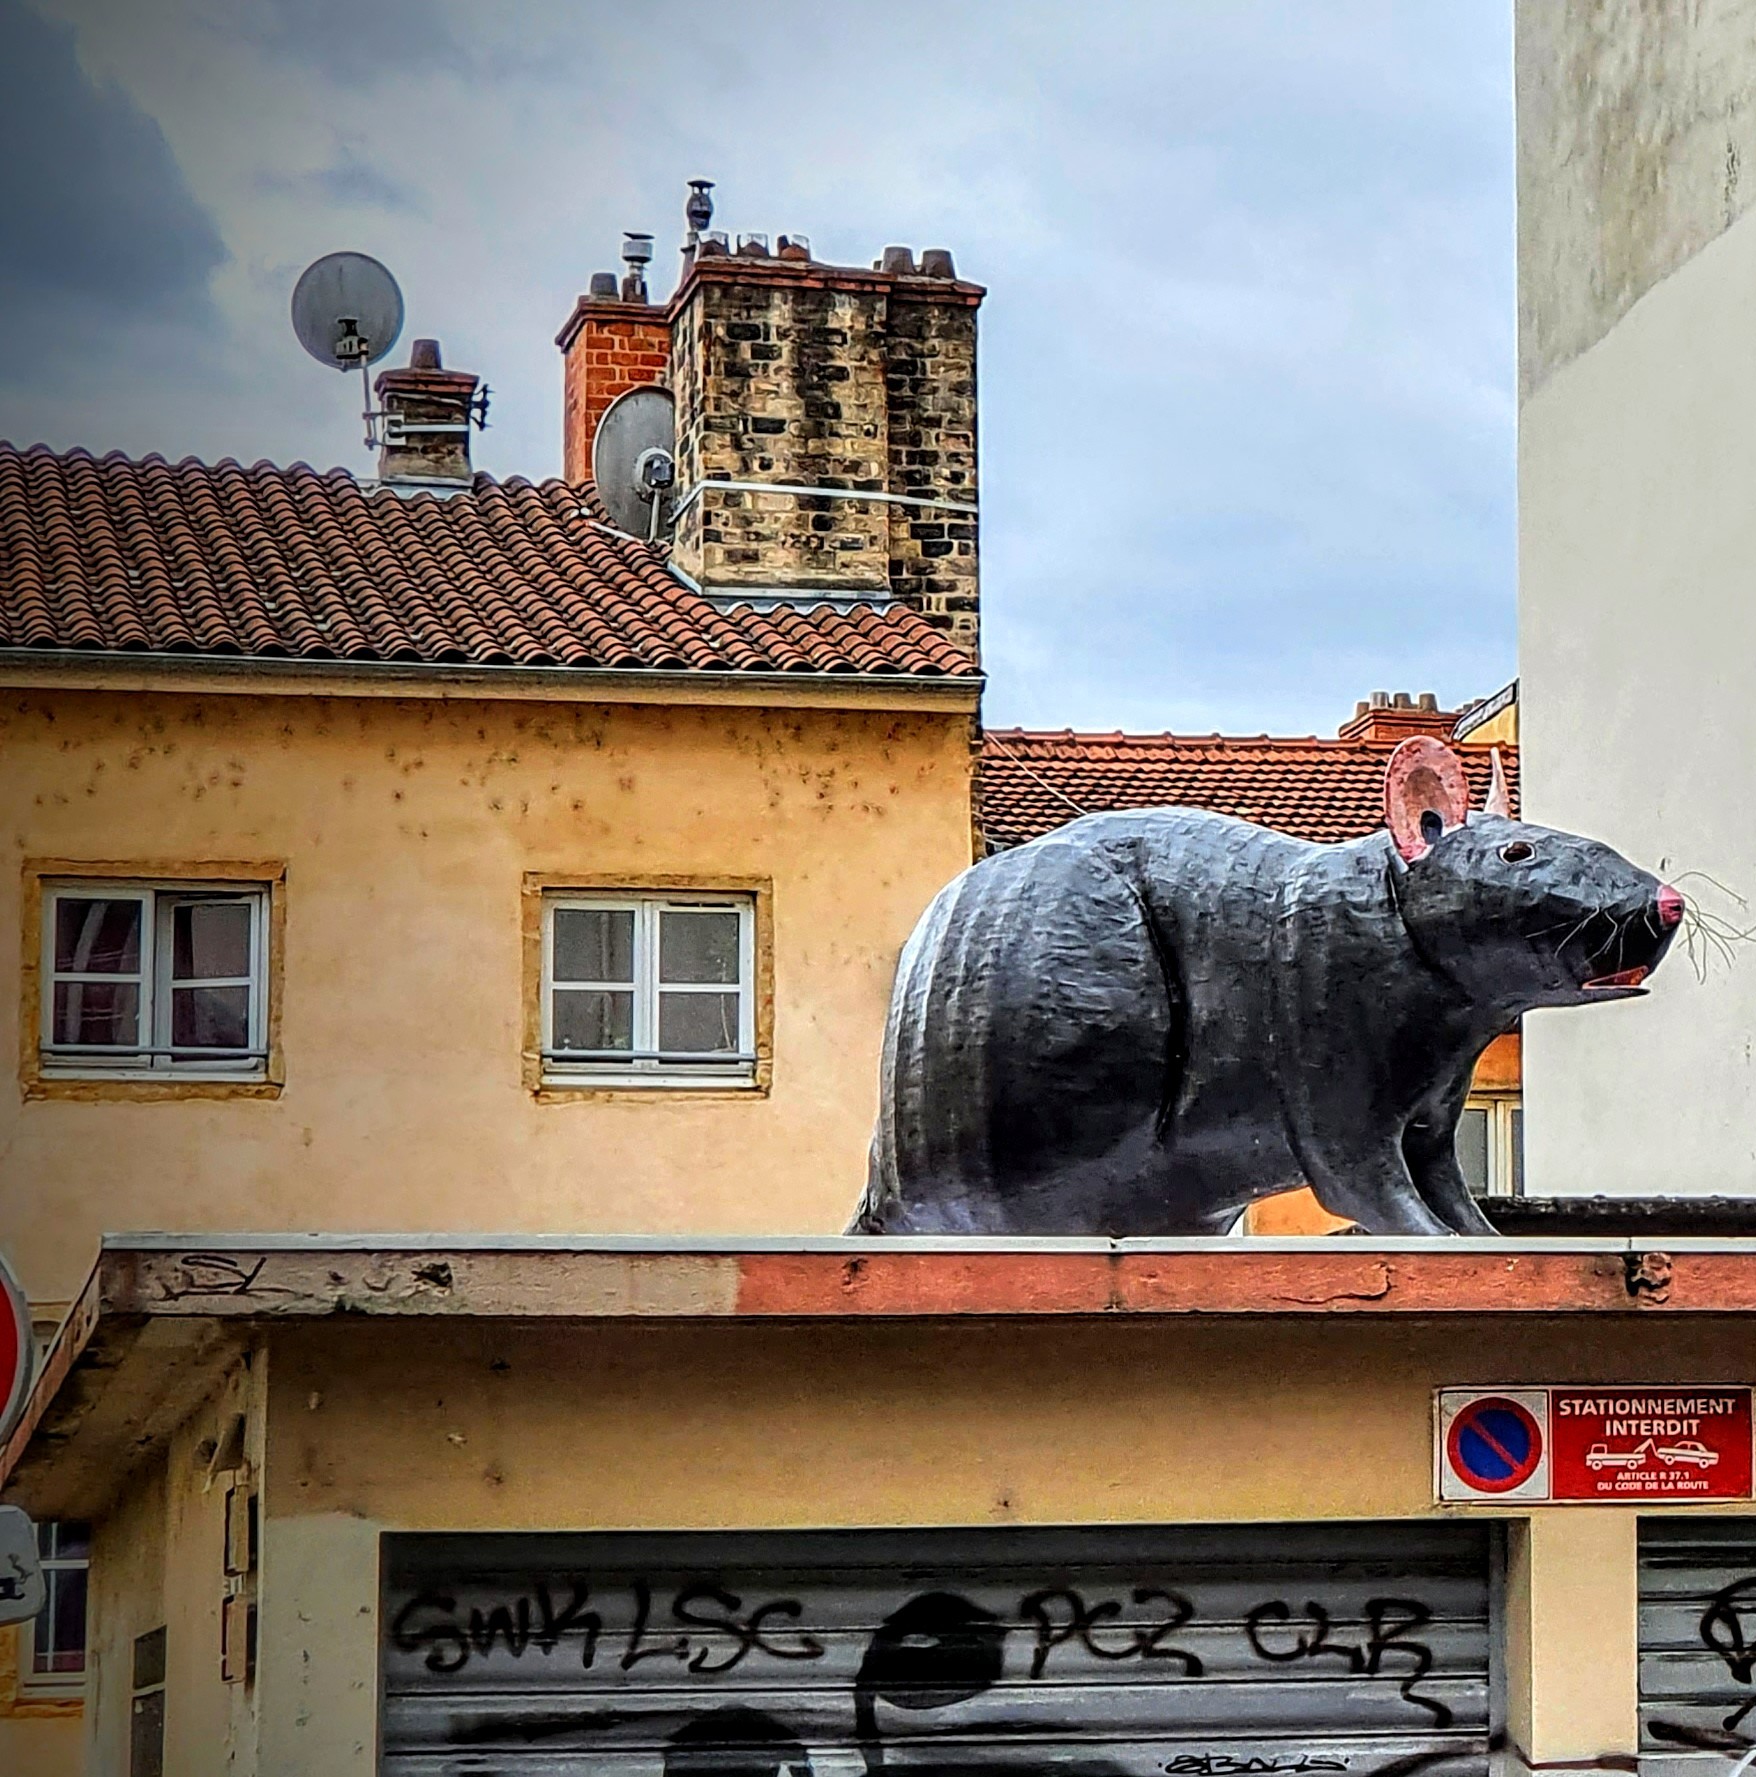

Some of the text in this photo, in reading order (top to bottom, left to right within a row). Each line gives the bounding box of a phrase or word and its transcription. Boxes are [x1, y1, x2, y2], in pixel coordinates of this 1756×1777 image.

[1559, 1399, 1736, 1416] STATIONNEMENT
[1605, 1419, 1700, 1436] INTERDIT
[1616, 1472, 1657, 1481] ARTICLE
[1660, 1472, 1667, 1480] R
[1597, 1481, 1709, 1490] DU CODE DE LA ROUTE
